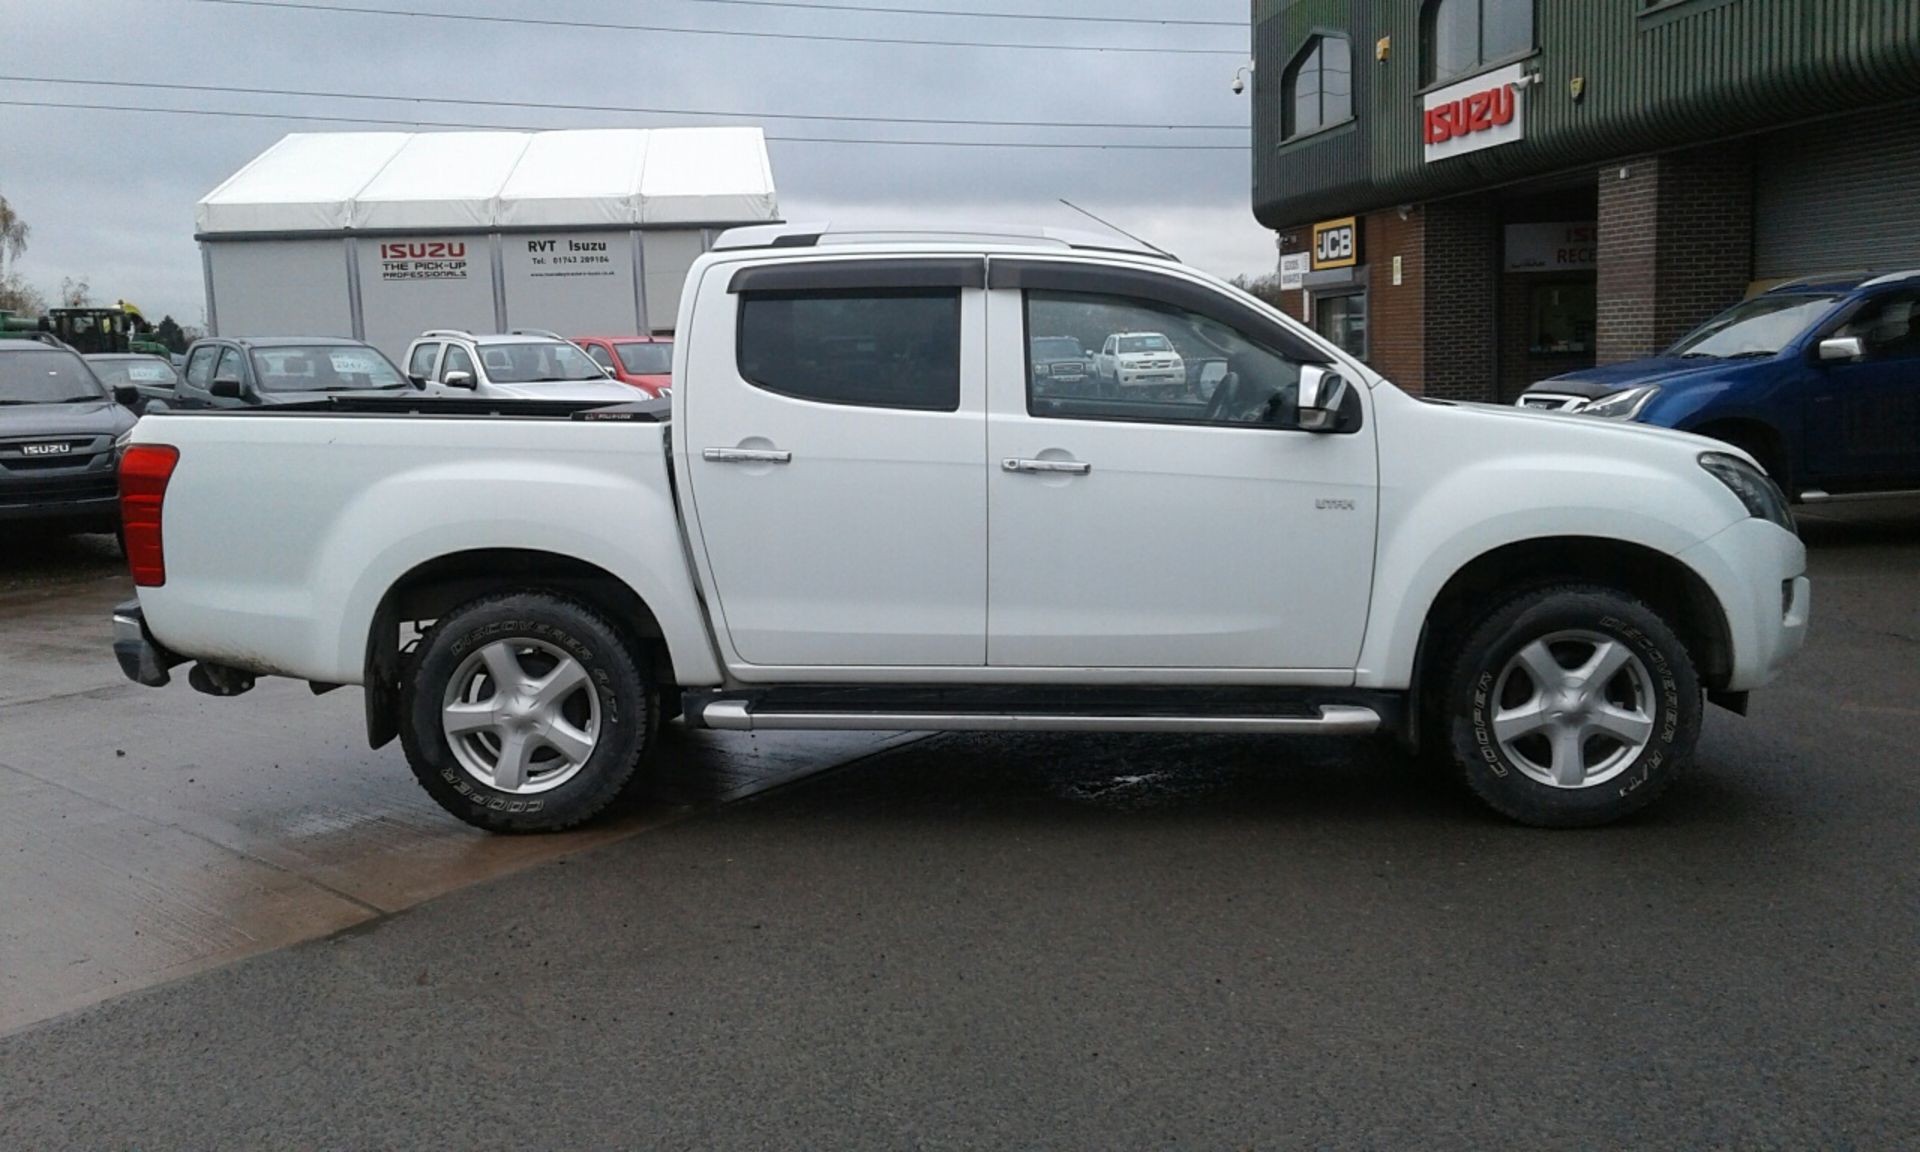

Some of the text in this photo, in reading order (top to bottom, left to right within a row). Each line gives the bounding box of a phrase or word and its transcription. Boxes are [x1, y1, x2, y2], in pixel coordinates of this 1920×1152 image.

[1424, 83, 1514, 144] ISUZU
[381, 242, 465, 259] ISUZU
[528, 240, 607, 252] RVT Isuzu
[1318, 228, 1352, 260] JCB
[382, 261, 467, 271] THE PICK-UP
[553, 256, 577, 264] 01743
[383, 270, 468, 279] PROFESSIONALS
[24, 443, 69, 454] ISUZU
[450, 619, 594, 661] DISCOVERER
[1599, 615, 1681, 744] DISCOVERER
[1472, 671, 1509, 779] COOPER
[439, 767, 545, 813] COOPER
